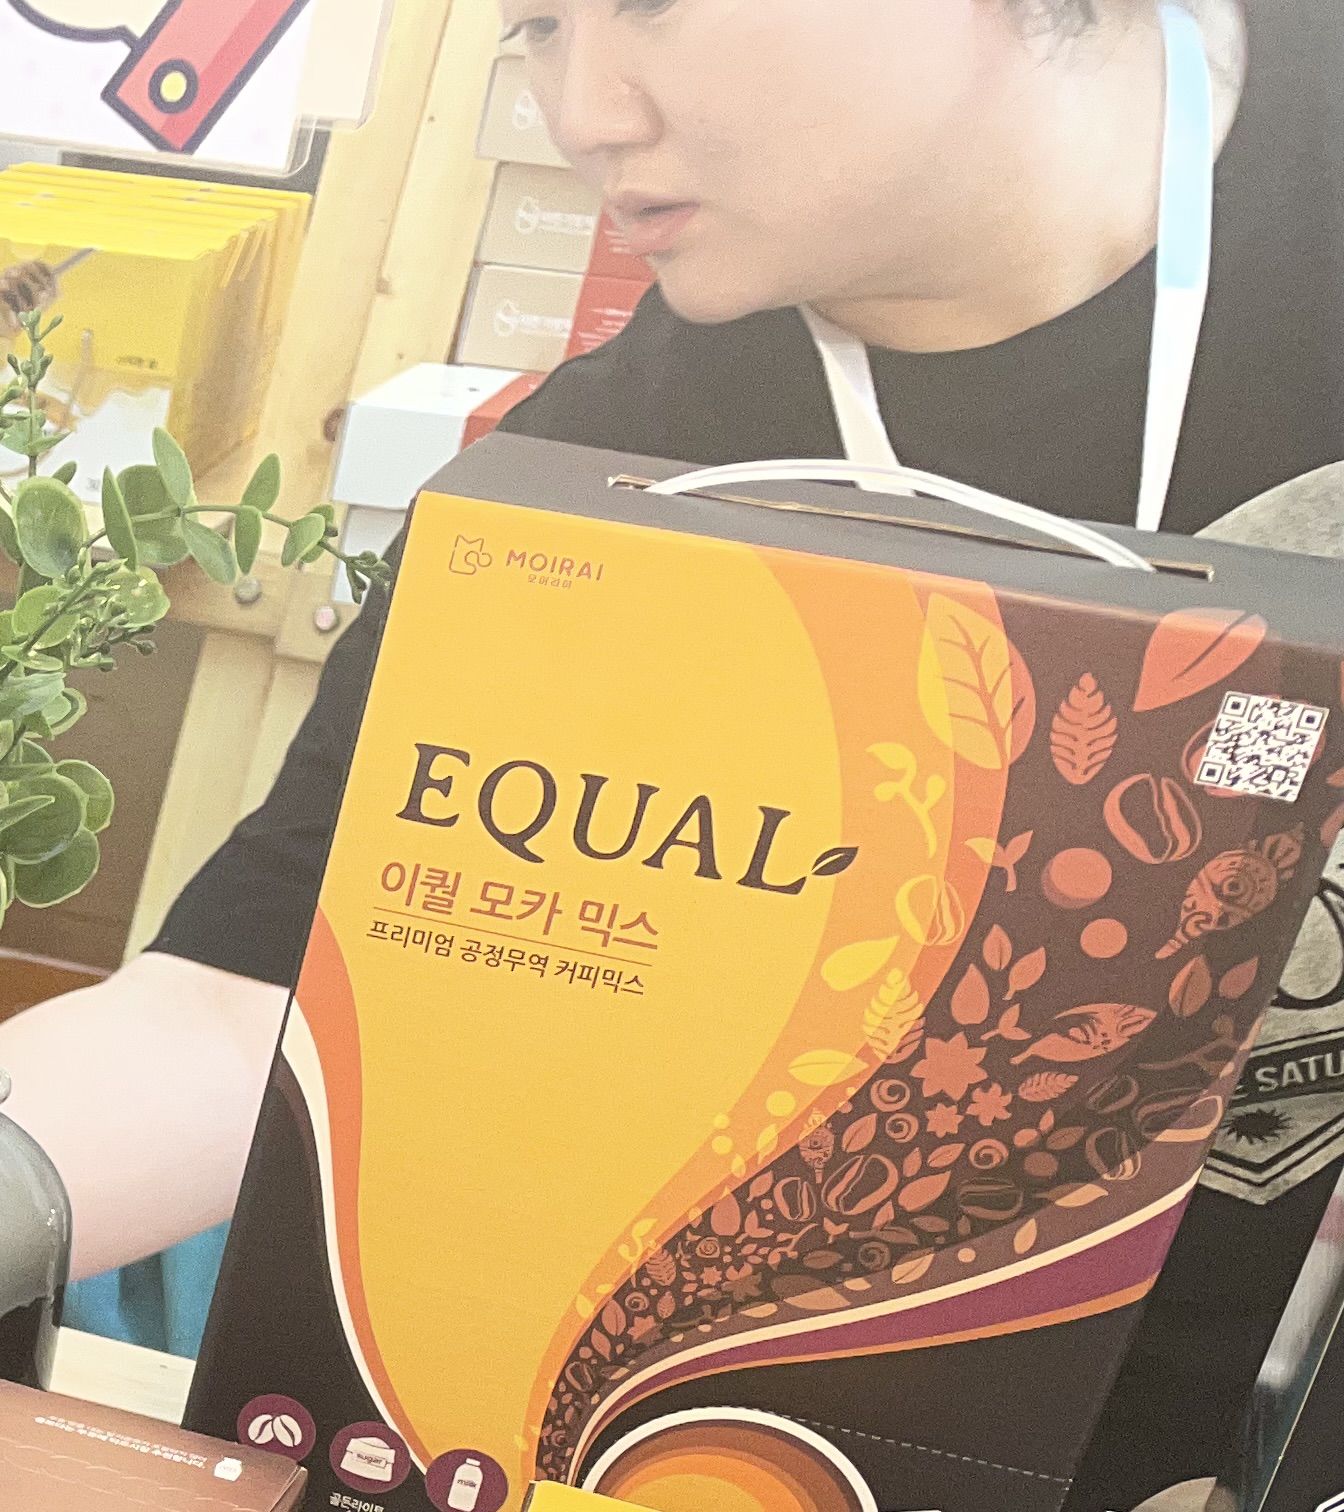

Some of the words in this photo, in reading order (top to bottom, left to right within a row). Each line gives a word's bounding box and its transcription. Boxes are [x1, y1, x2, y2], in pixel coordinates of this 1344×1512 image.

[506, 547, 604, 583] MOIRAI
[395, 742, 806, 897] EQUAL
[379, 859, 461, 913] 이퀄
[471, 879, 562, 937] 모카
[578, 899, 660, 954] 믹스
[365, 918, 456, 957] 프리미엄
[460, 936, 548, 978] 공정무역
[555, 958, 645, 998] 커피믹스
